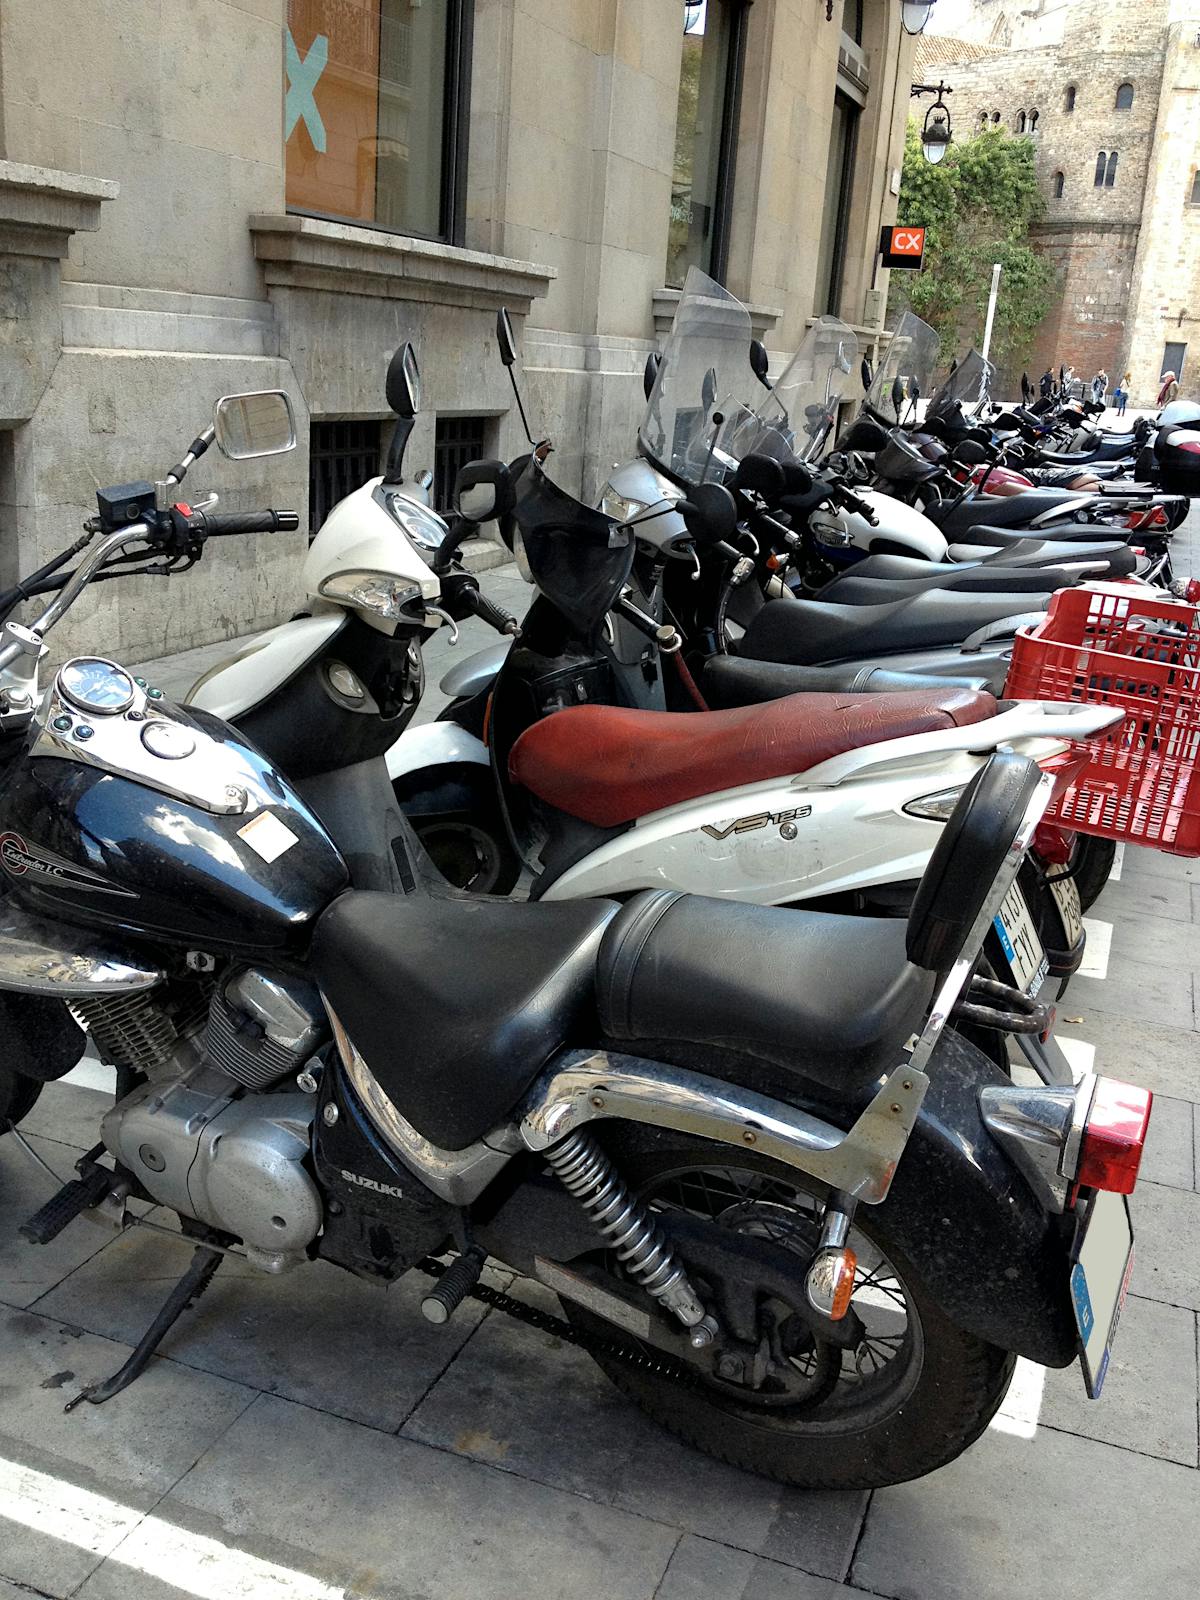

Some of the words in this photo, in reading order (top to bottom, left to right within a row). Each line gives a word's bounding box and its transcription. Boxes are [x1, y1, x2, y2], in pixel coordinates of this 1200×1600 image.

[894, 232, 921, 250] CX
[1013, 923, 1037, 979] FYY
[341, 1169, 403, 1199] SUZUKI
